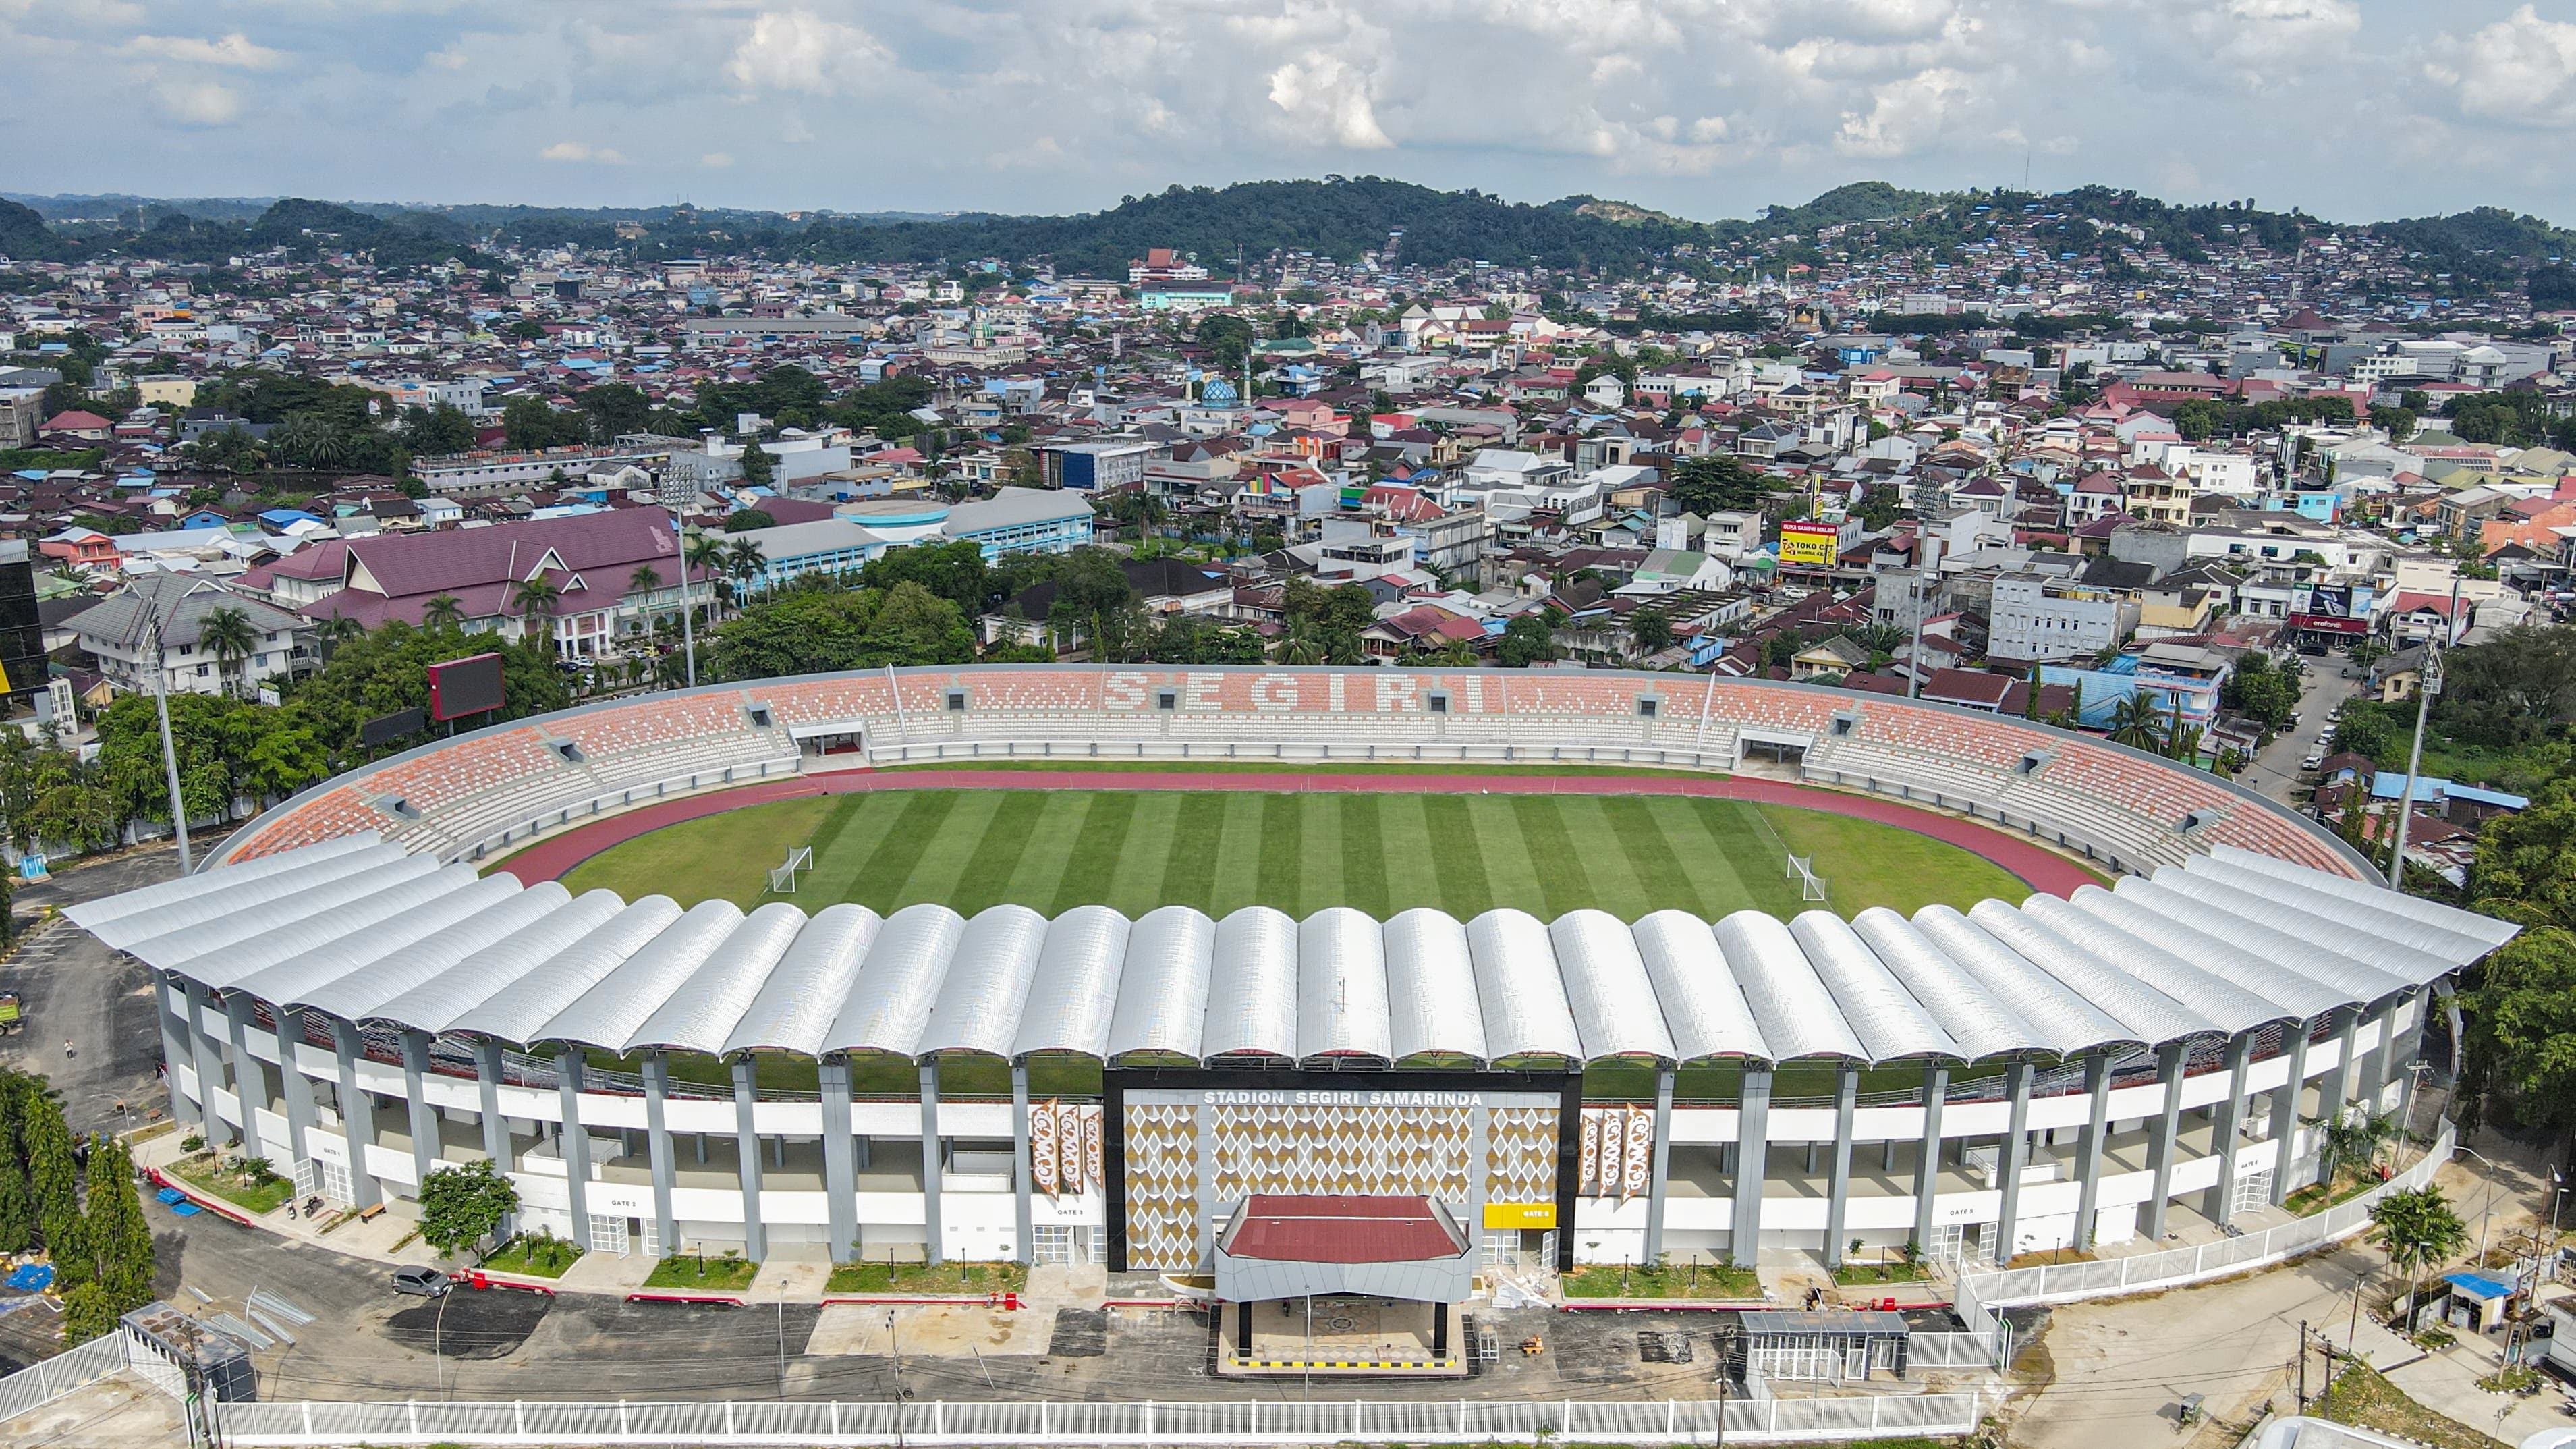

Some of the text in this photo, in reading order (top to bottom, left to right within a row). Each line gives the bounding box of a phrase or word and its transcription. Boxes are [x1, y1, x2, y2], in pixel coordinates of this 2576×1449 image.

[1797, 541, 1817, 550] TOKO
[1104, 671, 1484, 714] SEGIRI
[1204, 1091, 1482, 1108] STADION SEGIRI SAMARINDA
[2241, 1160, 2254, 1168] GATE
